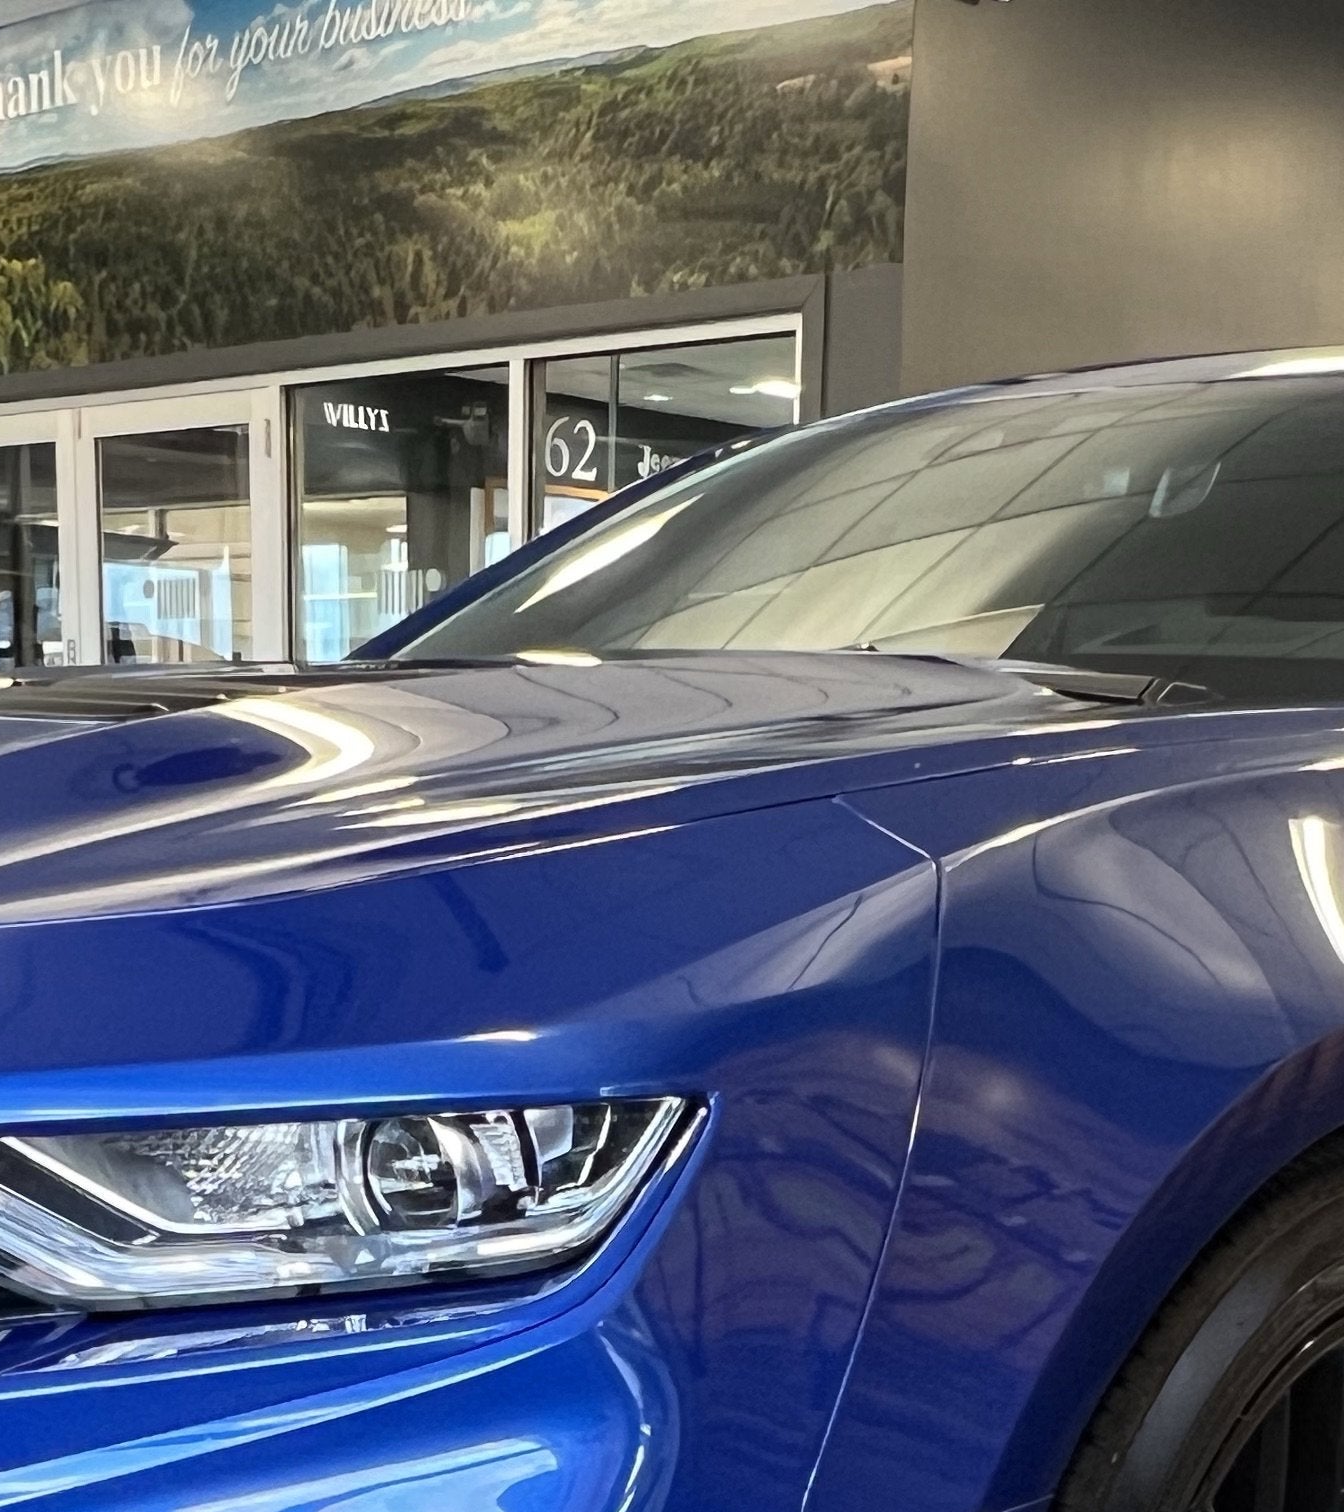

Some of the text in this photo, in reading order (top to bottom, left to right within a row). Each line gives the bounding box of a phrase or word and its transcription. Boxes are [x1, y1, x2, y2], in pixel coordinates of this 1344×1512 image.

[89, 44, 161, 116] you
[170, 24, 223, 106] for
[228, 19, 313, 99] your
[323, 402, 389, 432] WILLYS
[545, 416, 598, 481] 62
